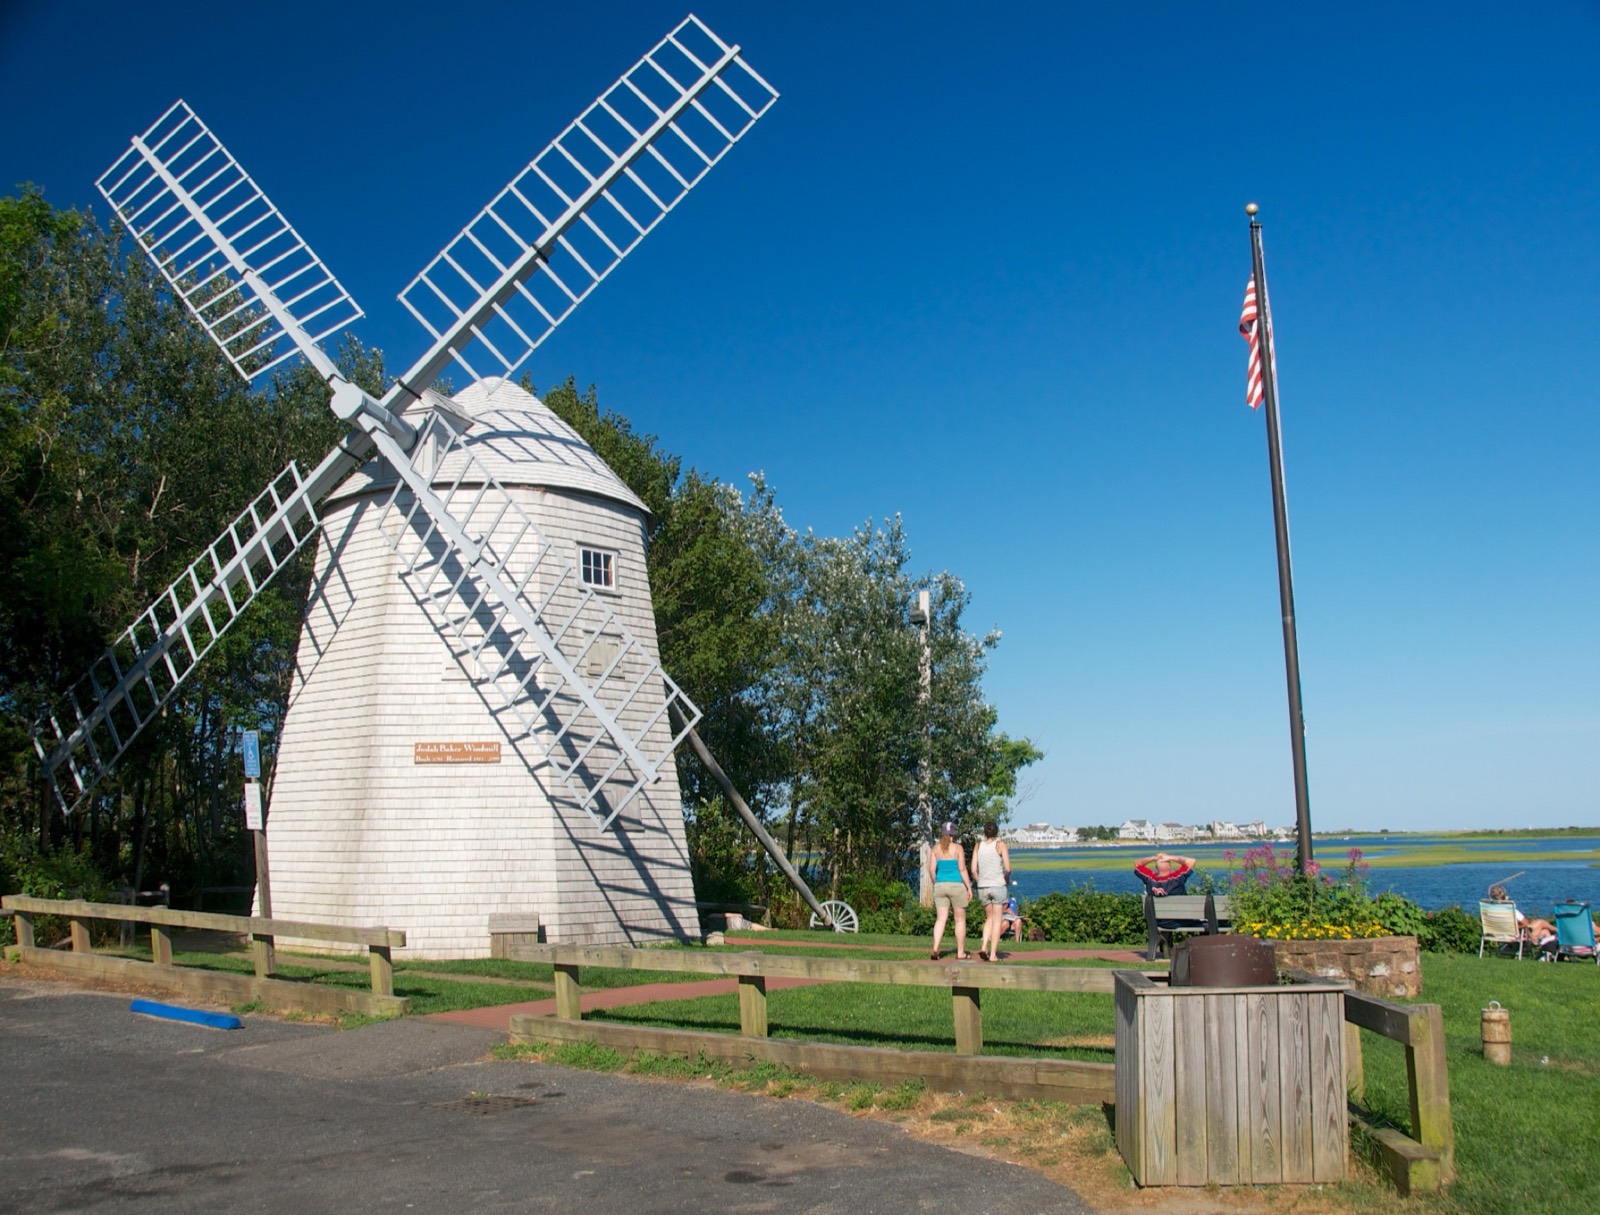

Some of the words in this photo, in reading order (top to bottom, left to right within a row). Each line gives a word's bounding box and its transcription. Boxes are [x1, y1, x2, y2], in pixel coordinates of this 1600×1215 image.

[416, 744, 439, 752] Judah
[440, 744, 462, 752] Baker
[464, 744, 499, 752] Windmill
